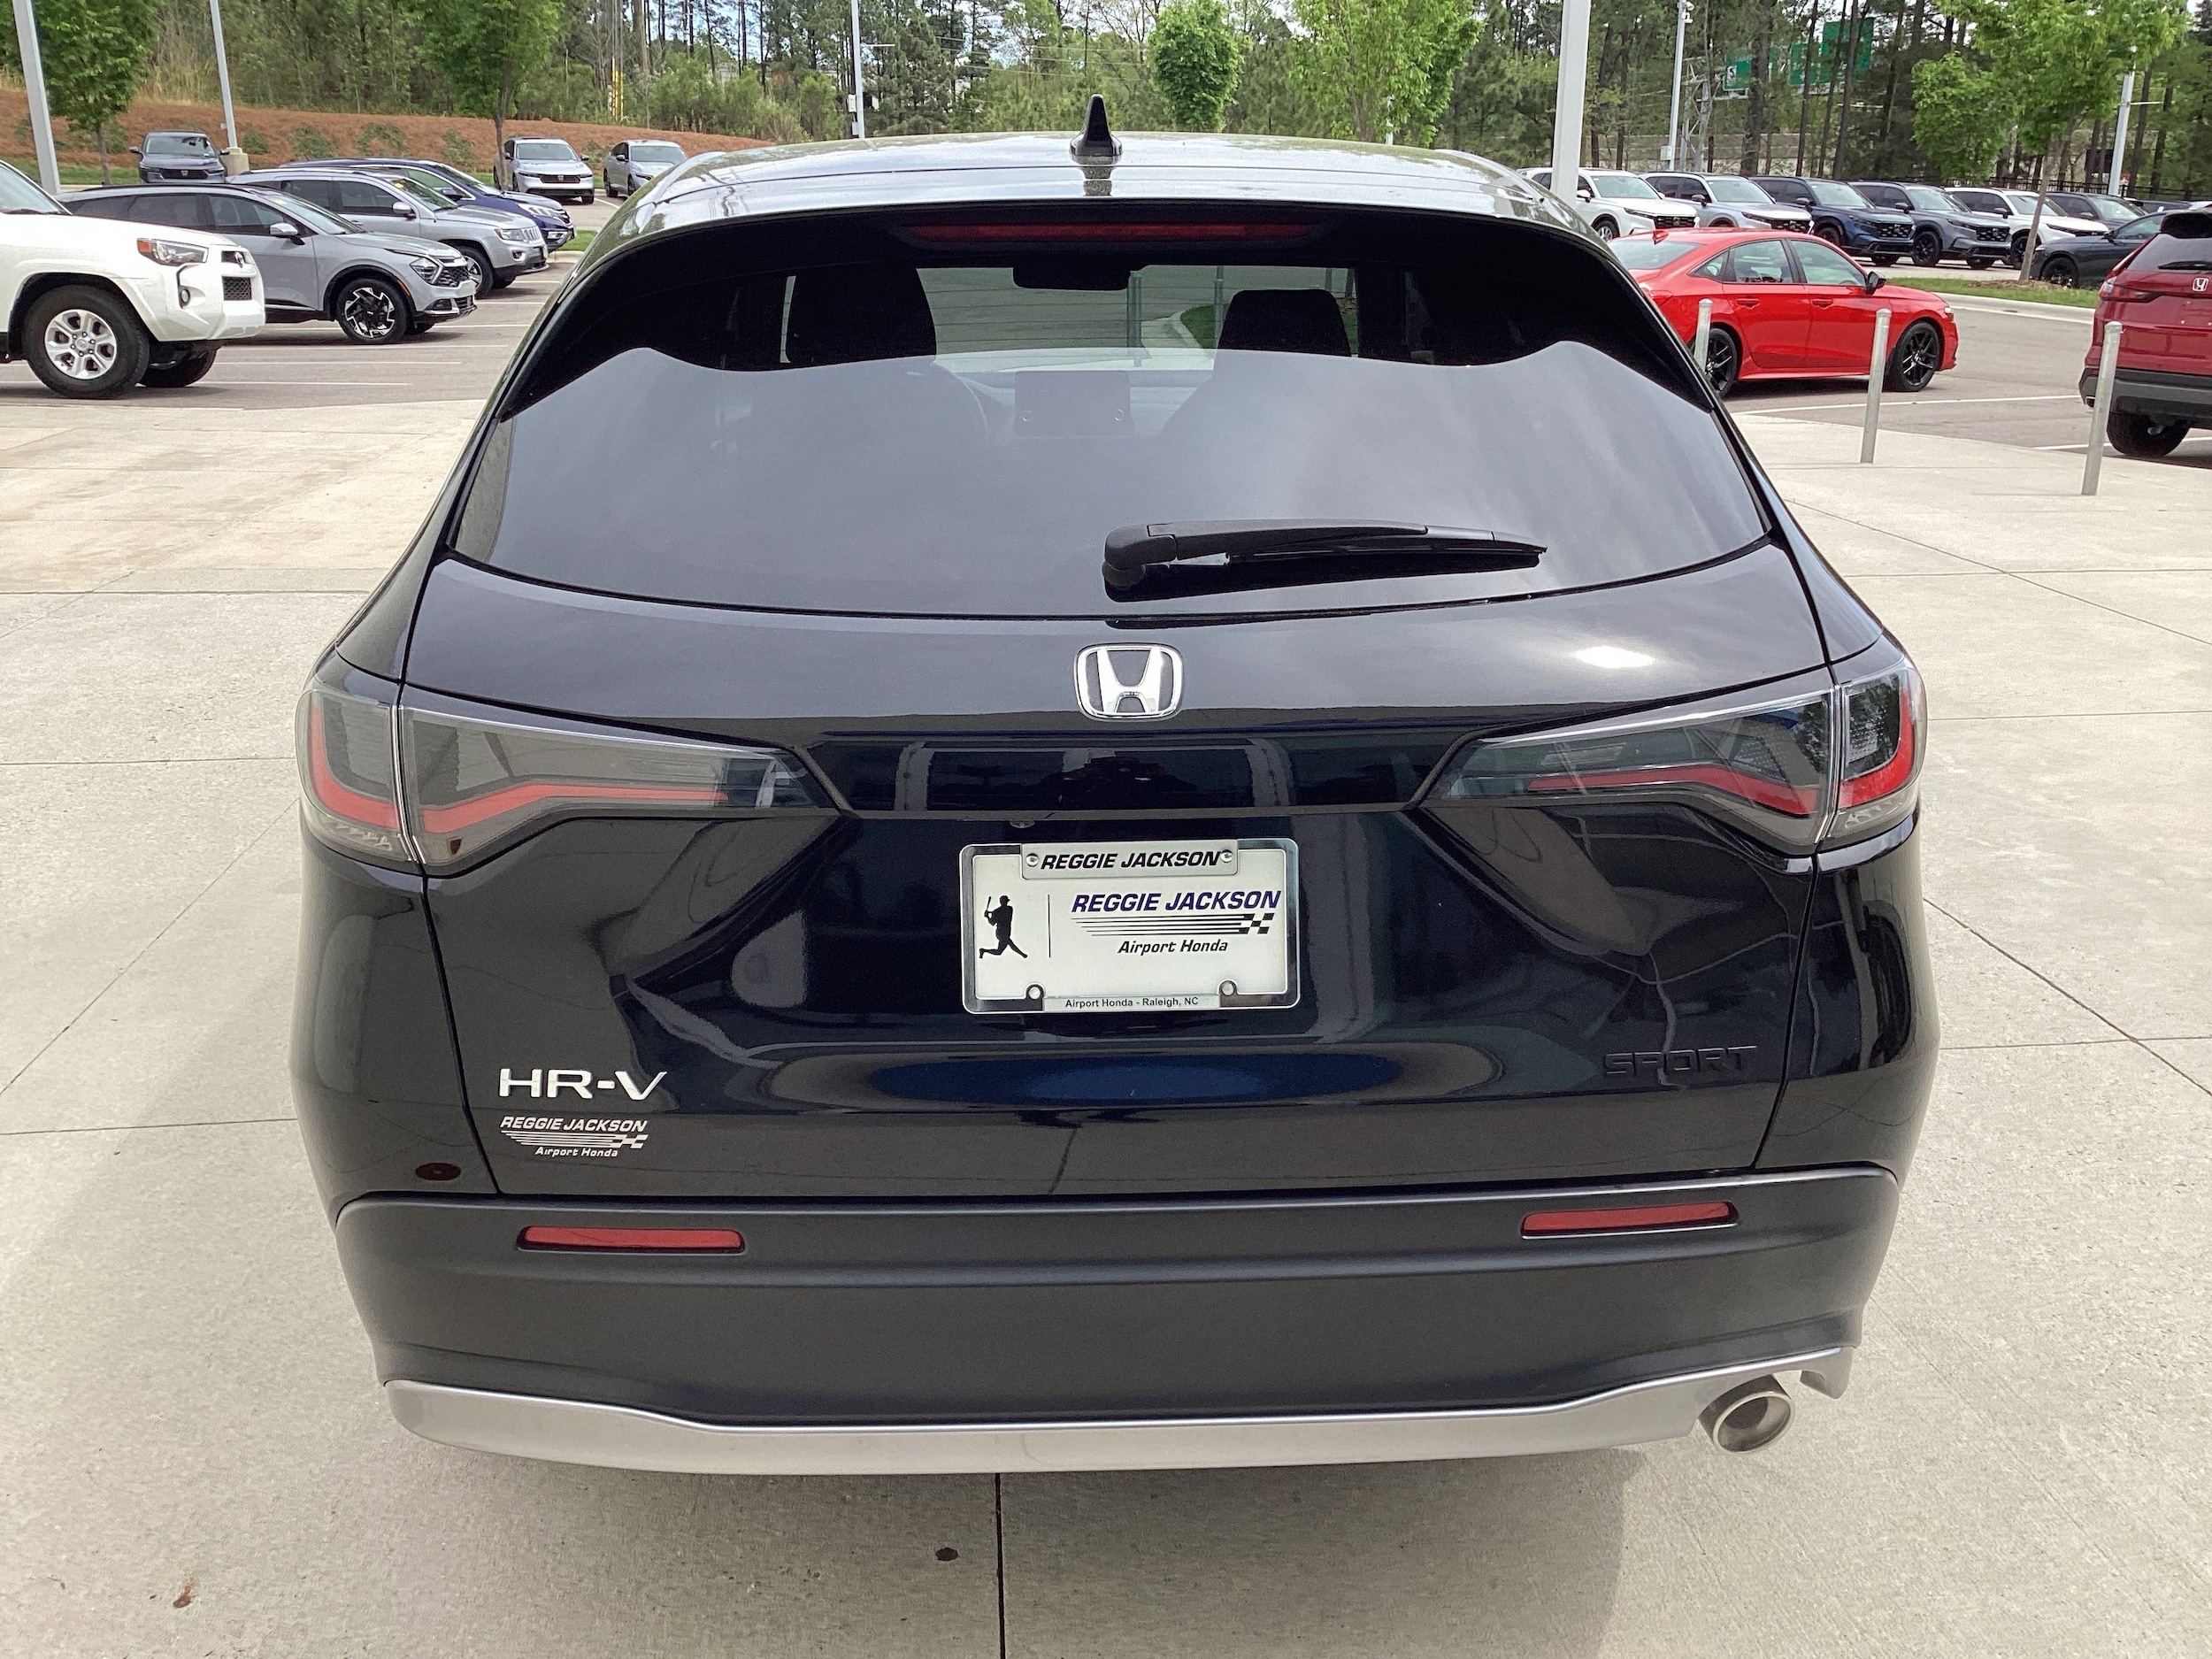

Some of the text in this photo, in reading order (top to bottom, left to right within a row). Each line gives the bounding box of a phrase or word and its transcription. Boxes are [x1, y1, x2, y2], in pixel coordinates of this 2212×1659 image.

[1041, 849, 1221, 870] REGGIE JACKSON
[1071, 890, 1282, 913] REGGIE JACKSON
[1118, 939, 1229, 956] Airport Honda
[1064, 997, 1099, 1009] Airport
[1102, 997, 1133, 1008] Honda
[1141, 996, 1182, 1009] Raleigh,
[1184, 996, 1199, 1006] NC
[1604, 1045, 1758, 1075] SPORT
[498, 1068, 668, 1101] HR-V
[499, 1116, 649, 1133] REGGIE JACKSON
[534, 1146, 618, 1158] Airport Honda
